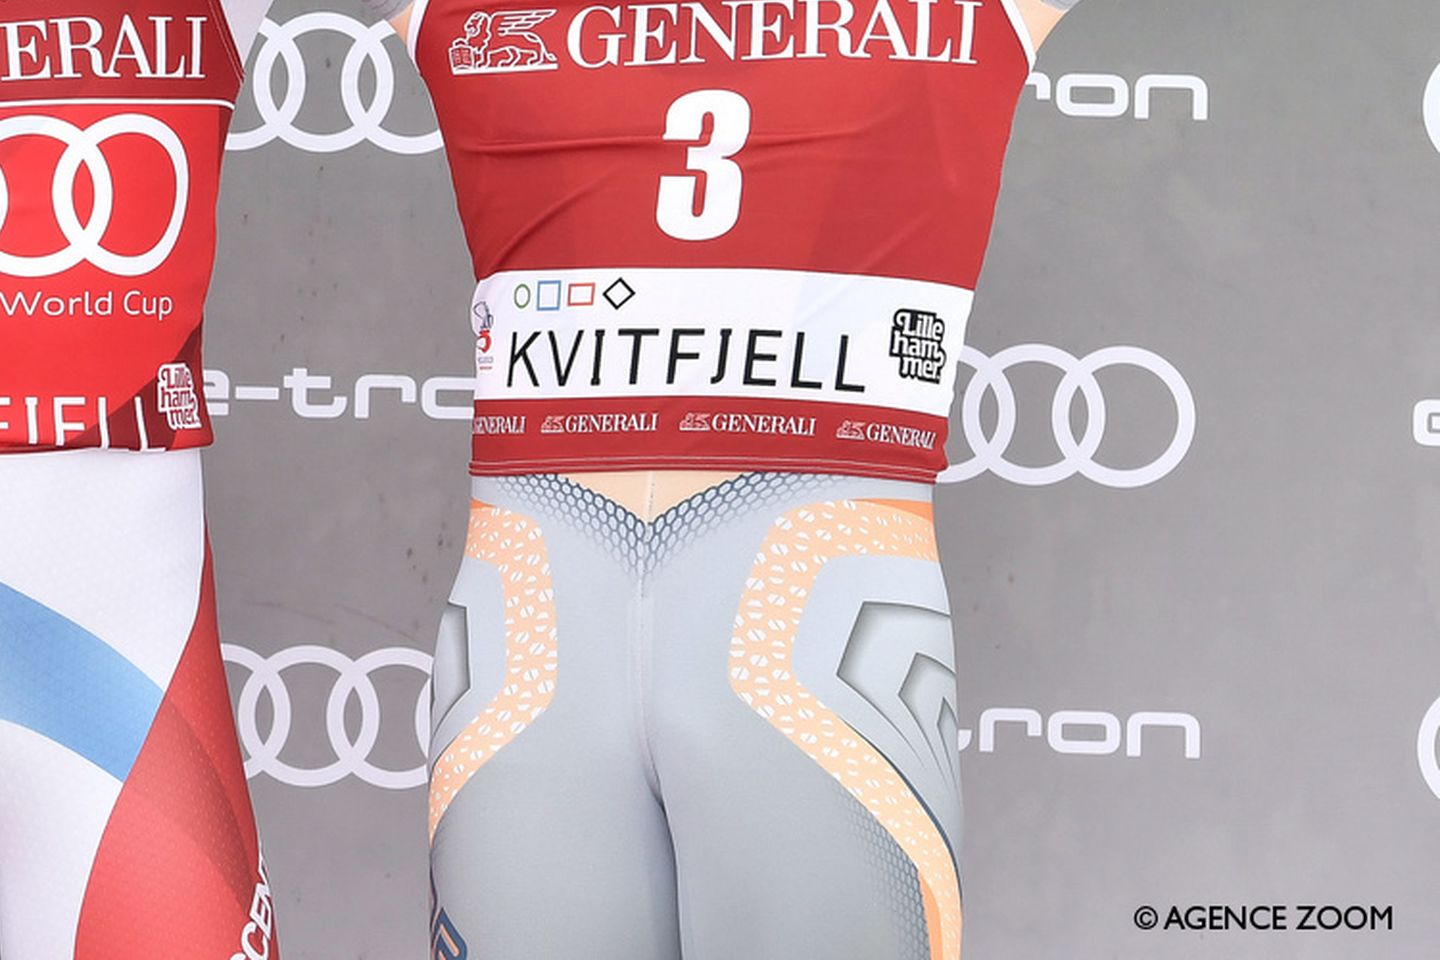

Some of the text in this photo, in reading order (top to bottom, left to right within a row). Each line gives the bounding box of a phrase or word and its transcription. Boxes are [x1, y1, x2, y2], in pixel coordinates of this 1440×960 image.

[655, 88, 751, 241] 3
[123, 290, 173, 321] Cup
[896, 311, 944, 341] Lille
[892, 330, 945, 360] ham
[507, 328, 866, 393] KVITFJELL
[565, 412, 659, 434] GENERALI
[711, 413, 817, 436] GENERALI
